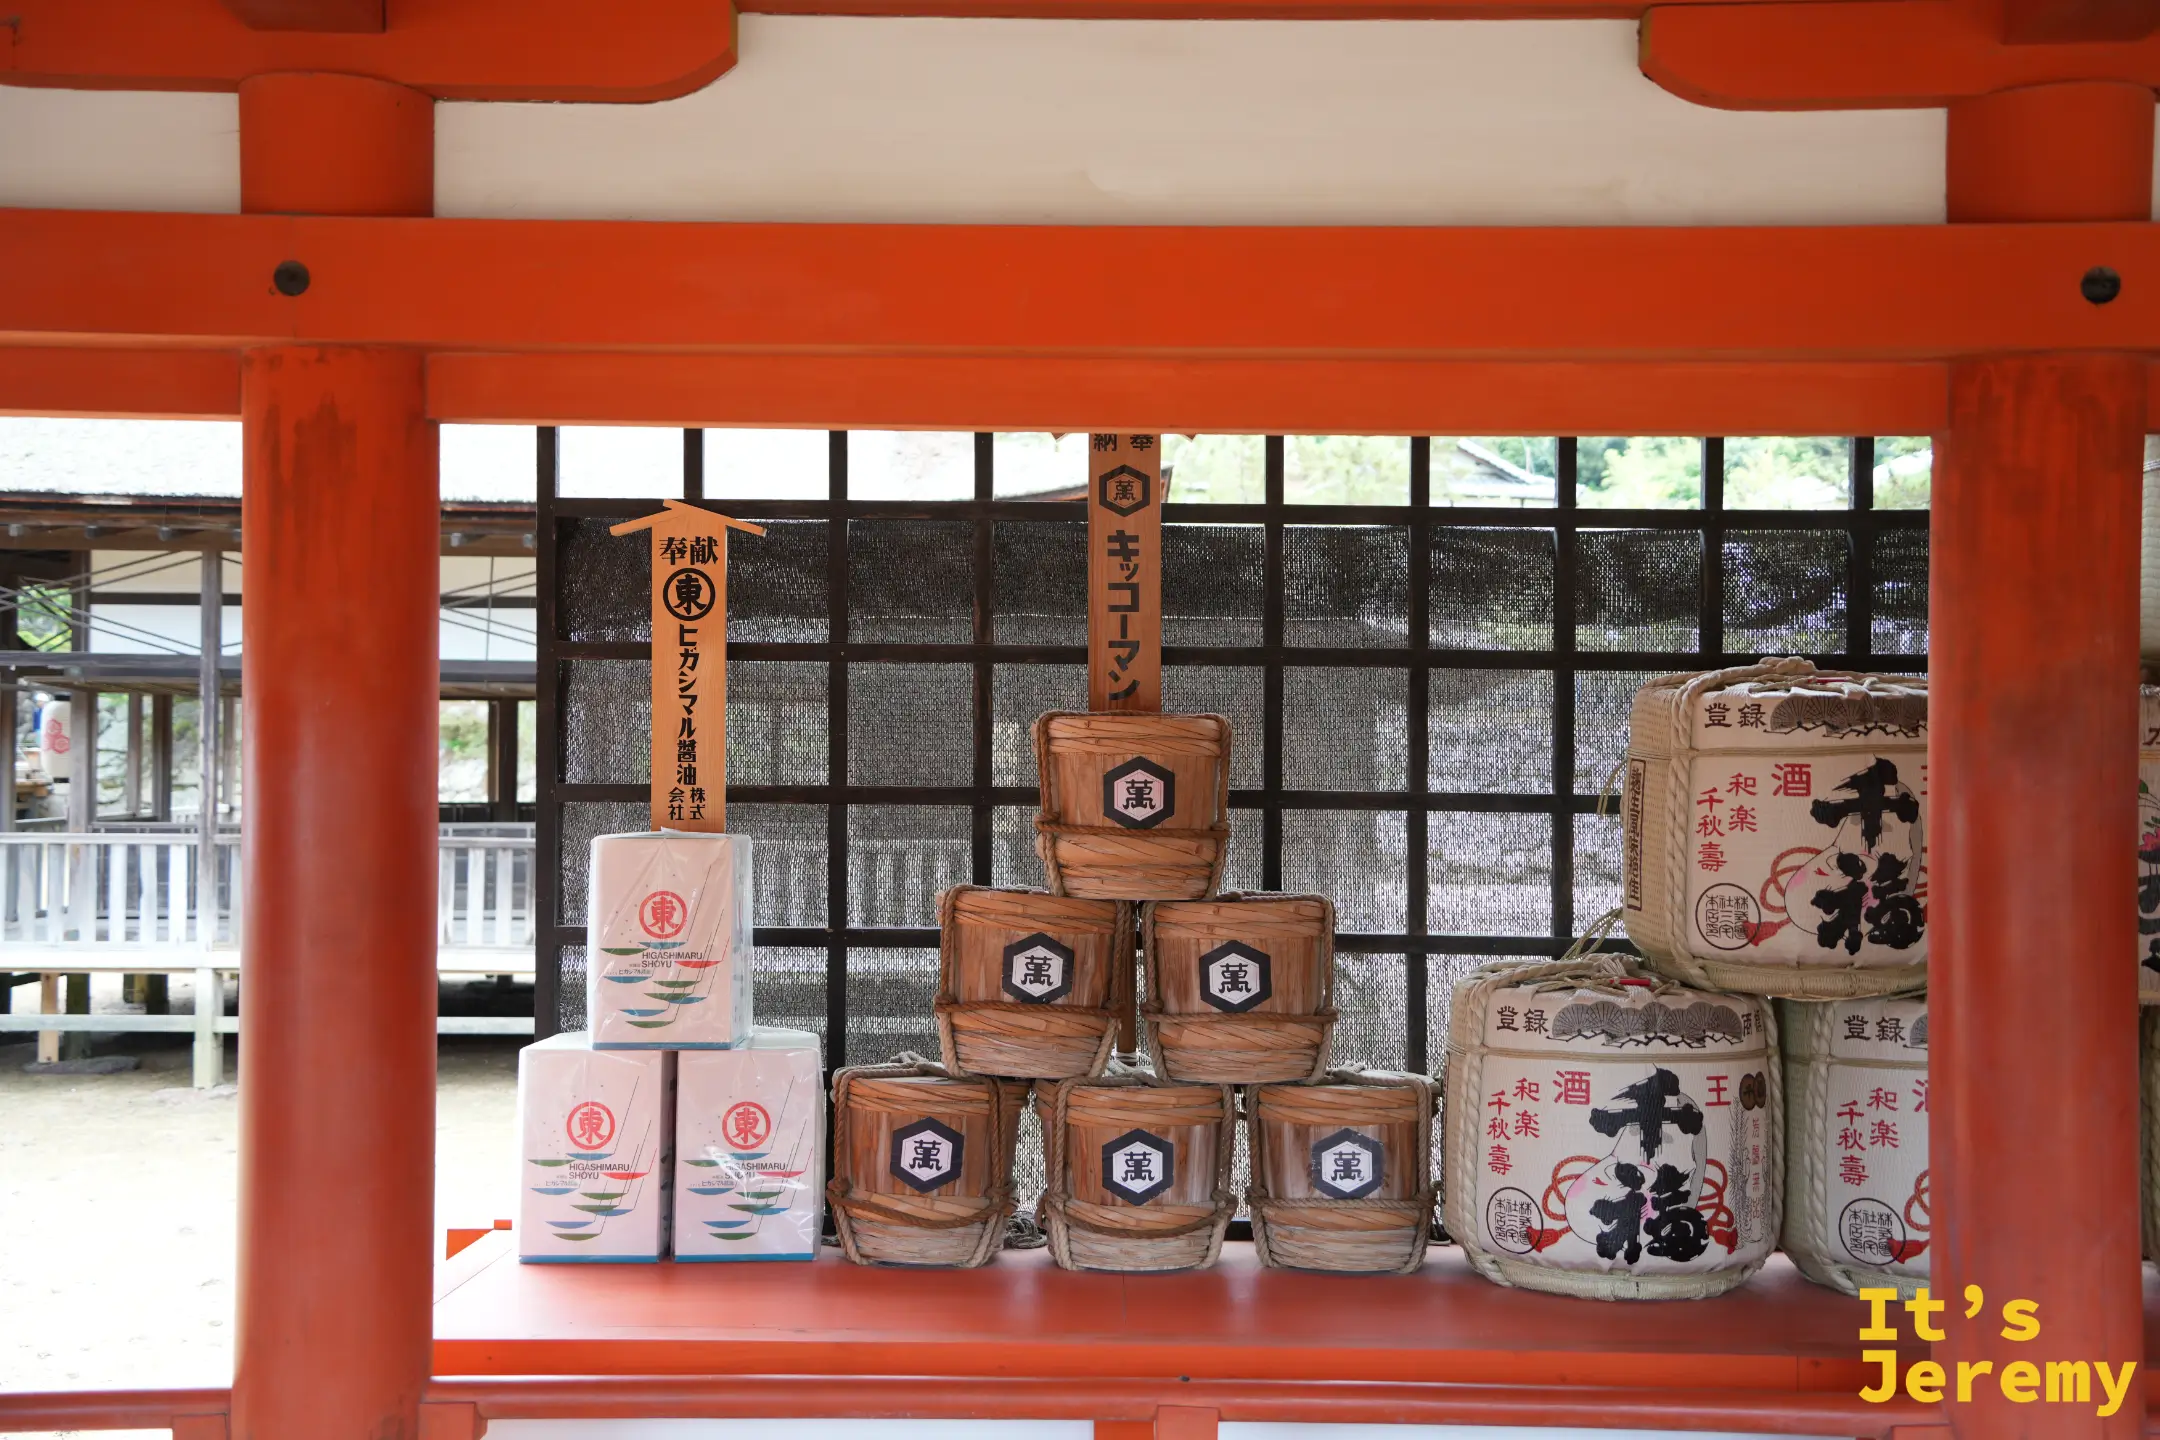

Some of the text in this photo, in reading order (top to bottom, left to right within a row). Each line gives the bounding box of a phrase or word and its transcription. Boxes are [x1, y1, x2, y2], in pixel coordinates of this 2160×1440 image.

[659, 535, 720, 566] 奉献
[1107, 529, 1141, 701] キッコーマン
[1704, 702, 1767, 729] 登録
[1771, 762, 1812, 798] 酒
[1809, 753, 1927, 956] 千福
[641, 960, 672, 968] SHOYU
[642, 951, 703, 960] HIGASHIMARU
[1496, 1005, 1550, 1035] 登録
[1843, 1014, 1906, 1044] 登録
[1552, 1070, 1592, 1106] 酒
[1705, 1075, 1732, 1107] 王
[569, 1163, 630, 1172] HIGASHIMARU
[569, 1172, 599, 1180] SHOYU
[1588, 1063, 1710, 1266] 千福
